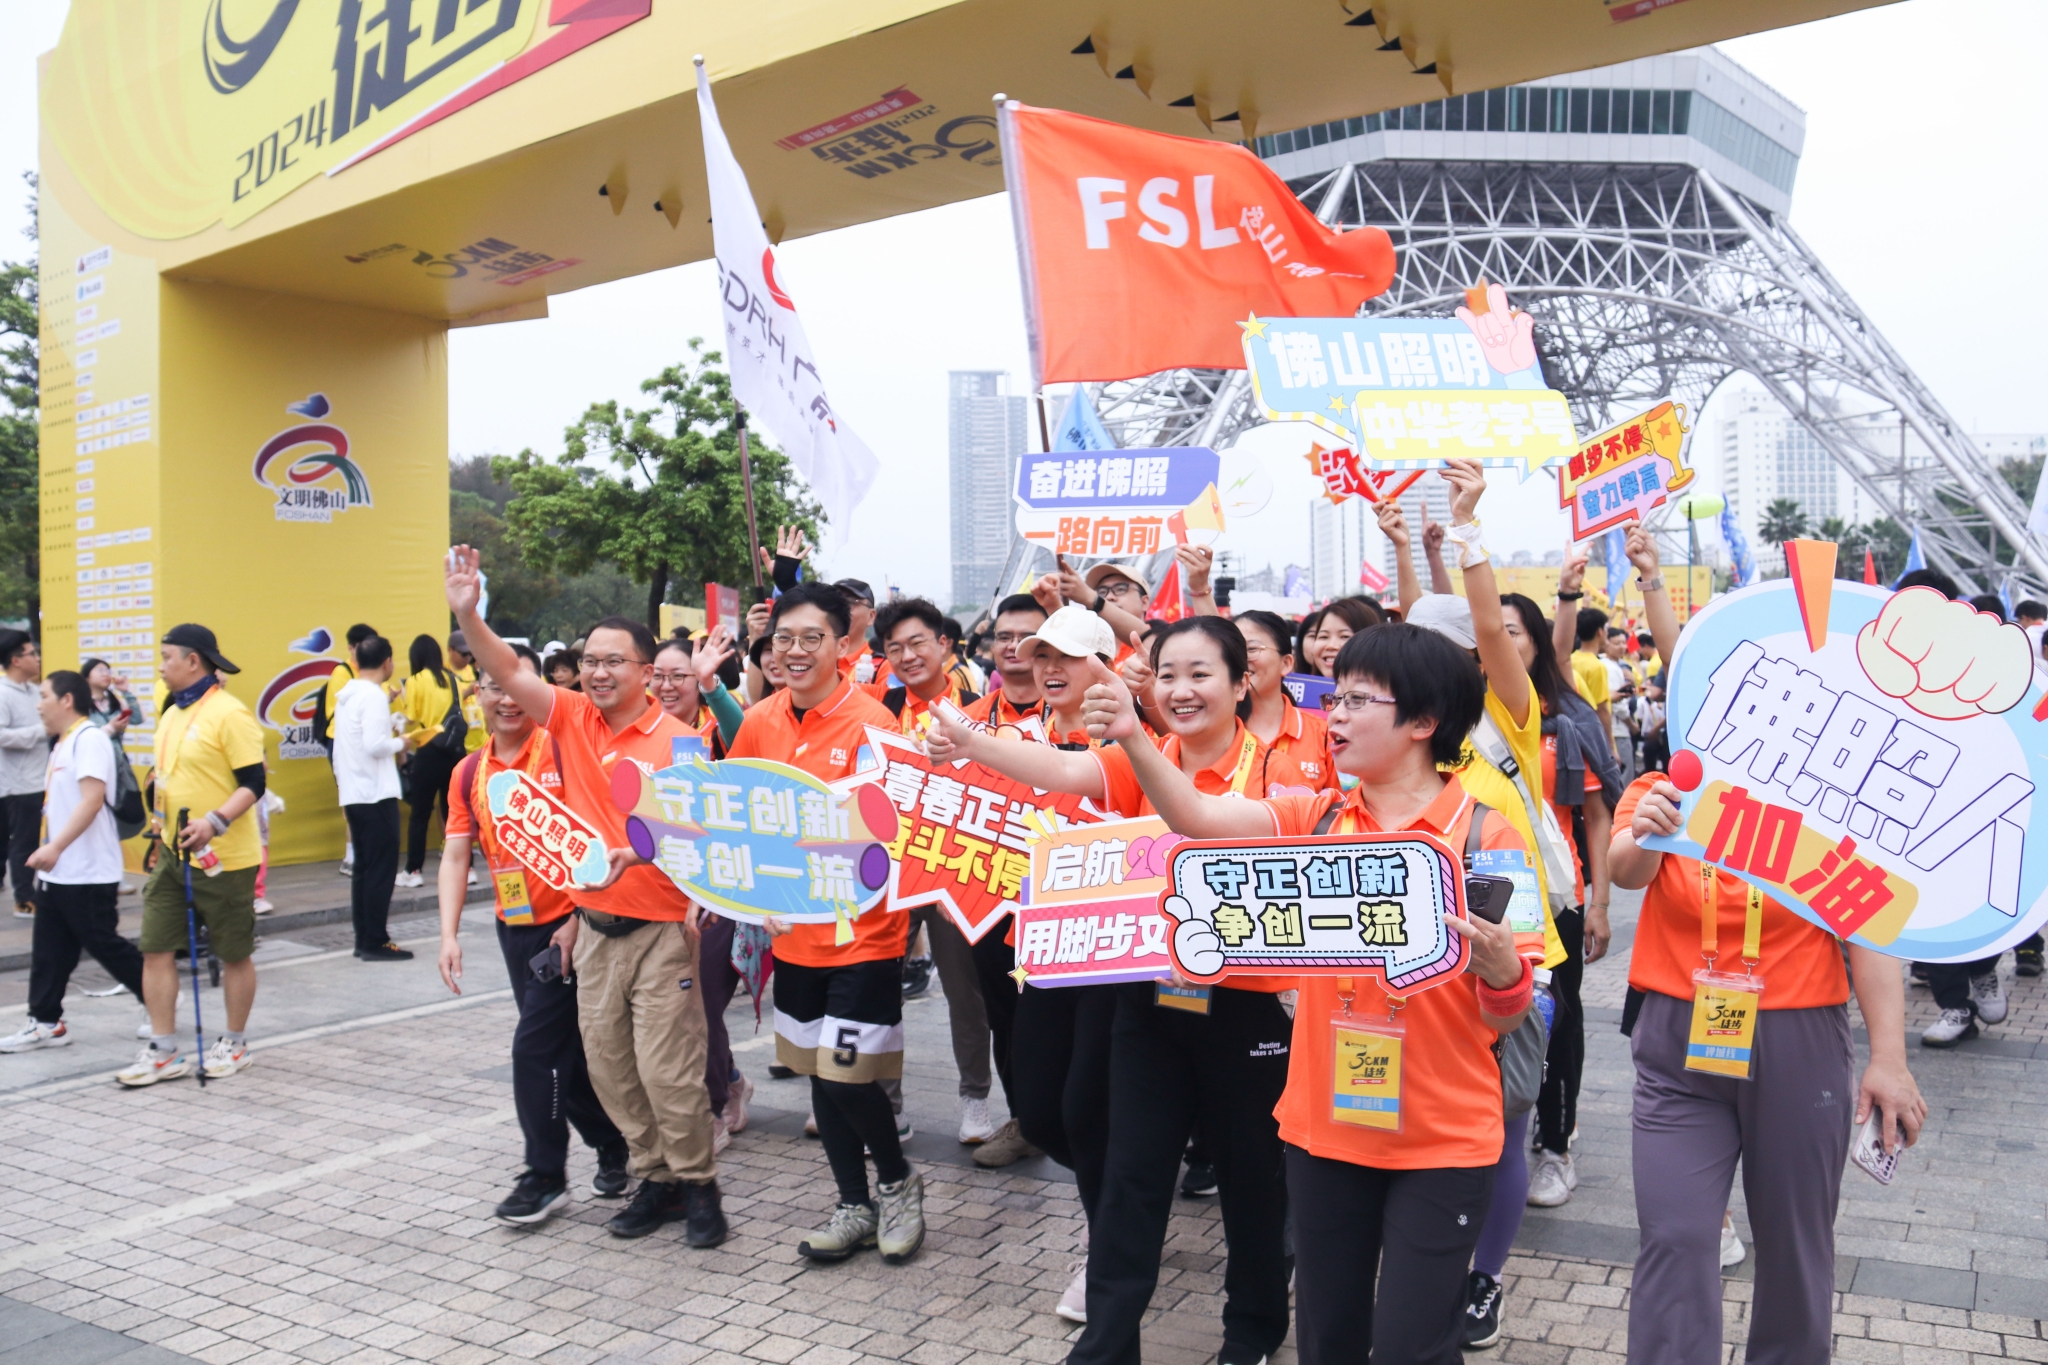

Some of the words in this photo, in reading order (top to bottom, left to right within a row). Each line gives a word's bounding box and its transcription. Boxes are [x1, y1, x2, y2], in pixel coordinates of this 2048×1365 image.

[232, 97, 327, 203] 2024
[1077, 174, 1241, 250] FSL
[1268, 331, 1491, 390] 佛山照明
[1361, 400, 1574, 450] 中华老字号
[277, 487, 345, 509] 文明佛山
[1030, 456, 1170, 499] 奋进佛照
[276, 508, 331, 520] FOSHAN
[1024, 516, 1163, 554] 一路向前
[676, 752, 693, 761] FSL
[830, 748, 847, 759] FSL
[1300, 761, 1320, 773] FSL
[541, 772, 561, 782] FSL
[1685, 640, 2036, 918] 佛照人
[509, 788, 588, 863] 佛山照明
[653, 775, 851, 840] 守正创新
[883, 760, 1090, 857] 青春正当
[504, 830, 560, 882] 中华老字号
[659, 835, 859, 902] 争创一流
[1204, 855, 1409, 899] 守正创新
[1475, 852, 1493, 861] FSL
[1703, 786, 1895, 941] 加油
[1213, 902, 1408, 946] 争创一流
[1721, 1019, 1742, 1029] 徒步
[832, 1026, 861, 1068] 5
[1365, 1067, 1386, 1078] 徒步
